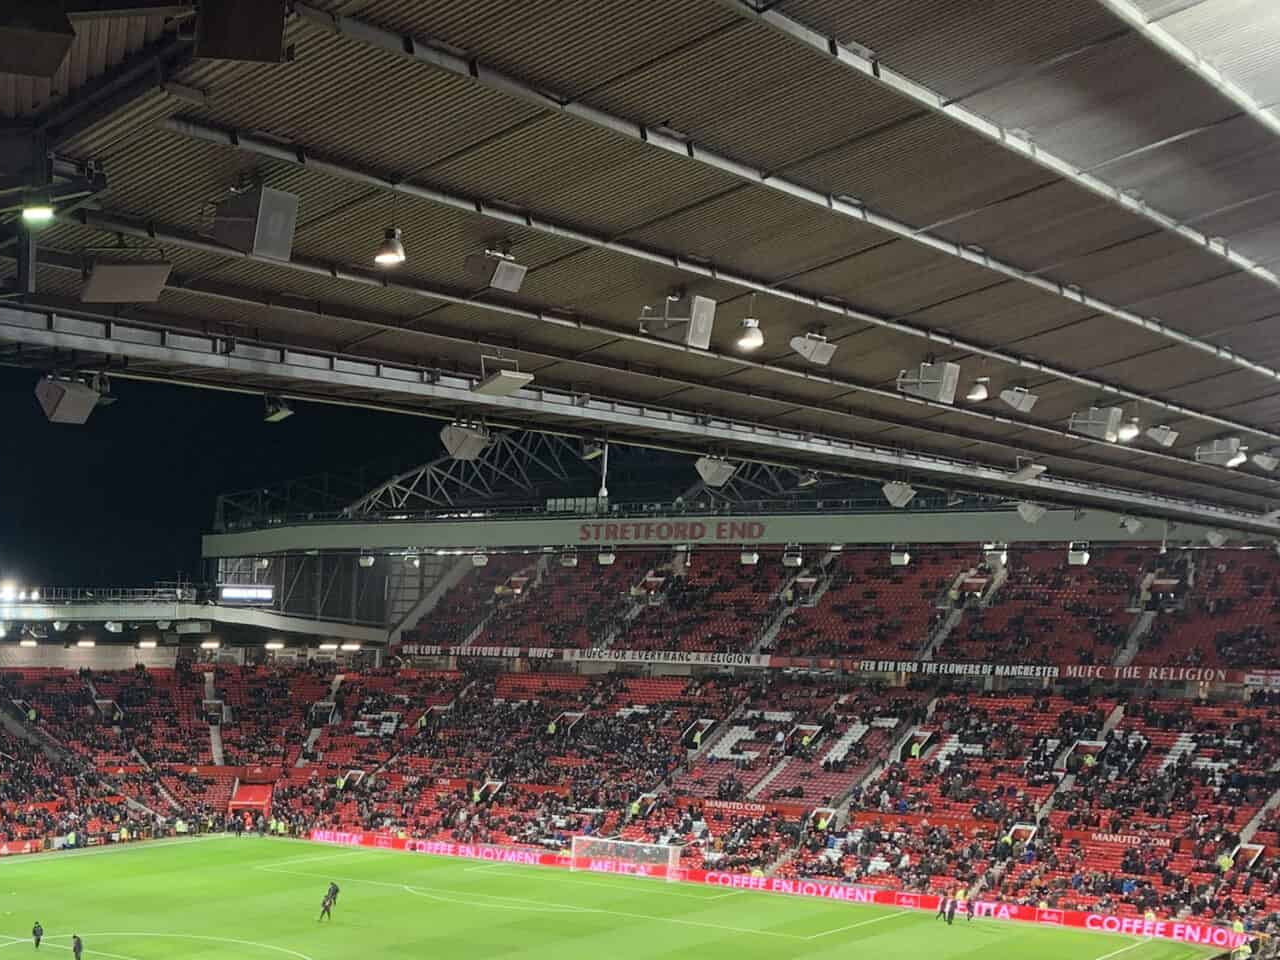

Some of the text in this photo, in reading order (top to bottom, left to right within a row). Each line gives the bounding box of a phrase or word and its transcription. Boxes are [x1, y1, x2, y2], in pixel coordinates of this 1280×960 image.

[579, 521, 766, 541] STRETFORD END
[449, 646, 500, 656] STRETFORD
[528, 647, 555, 658] MUFC
[703, 653, 753, 665] RELIGION
[922, 662, 937, 673] THE
[938, 663, 980, 675] FLOWERS
[982, 664, 993, 675] OF
[994, 665, 1059, 677] MANCHESTER
[1065, 665, 1228, 681] MUFC THE RELIGION
[1091, 832, 1170, 847] MANUTDOM
[458, 845, 542, 865] ENJOYMENT
[704, 872, 766, 891] COFFEE
[772, 879, 877, 903] ENJOYMENT
[937, 896, 1011, 920] EITTA
[1085, 913, 1165, 939] COFFEE
